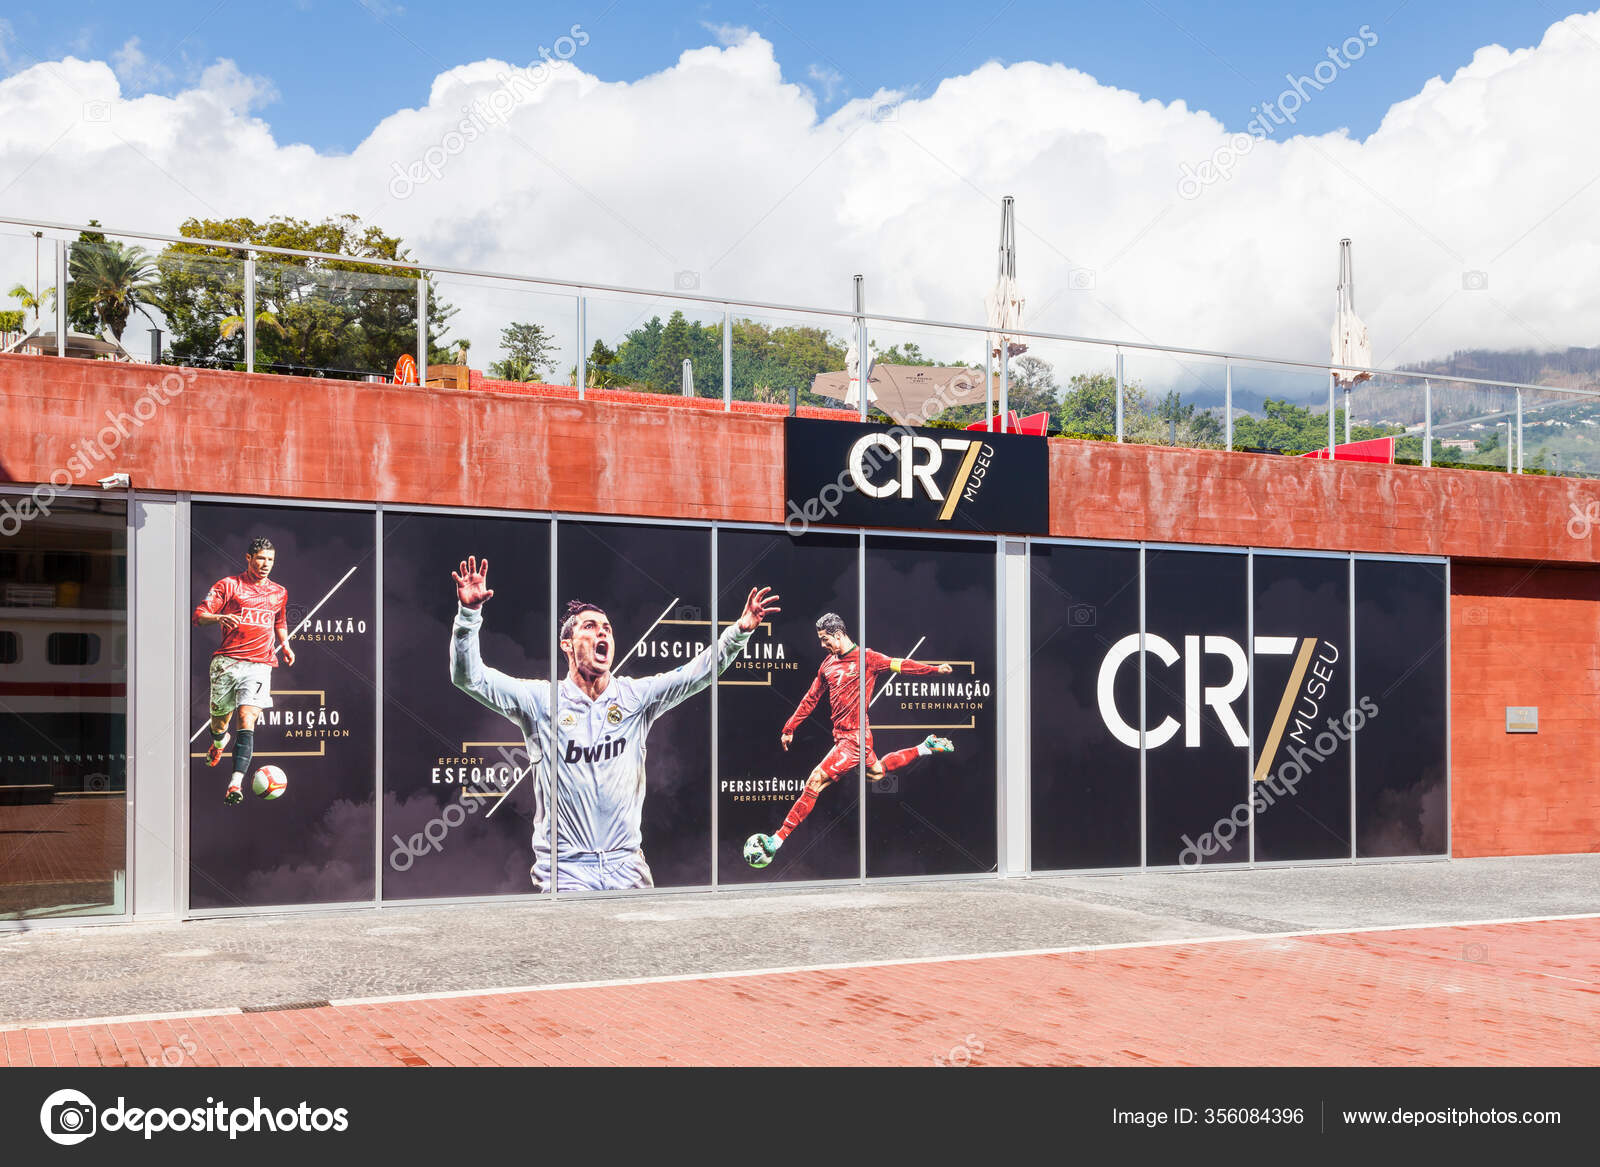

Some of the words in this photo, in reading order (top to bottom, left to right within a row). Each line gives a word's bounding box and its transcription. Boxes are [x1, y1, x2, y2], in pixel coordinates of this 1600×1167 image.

[849, 432, 983, 521] CR7
[963, 443, 994, 502] MUSEU
[242, 610, 272, 625] AIG
[303, 617, 366, 634] PAIXÃO
[735, 661, 799, 670] DISCIPLINE
[885, 680, 990, 700] DETERMINAÇÃO
[1289, 640, 1339, 745] MUSEU
[901, 702, 983, 710] DETERMINATION
[1097, 632, 1318, 781] CR7
[257, 708, 340, 729] AMBIÇÃO
[285, 730, 350, 738] AMBITION
[564, 735, 627, 764] bwin
[438, 757, 484, 765] EFFORT
[431, 767, 523, 787] ESFORÇO
[721, 777, 806, 793] PERSISTÊNCIA
[733, 794, 796, 802] PERSISTENCE
